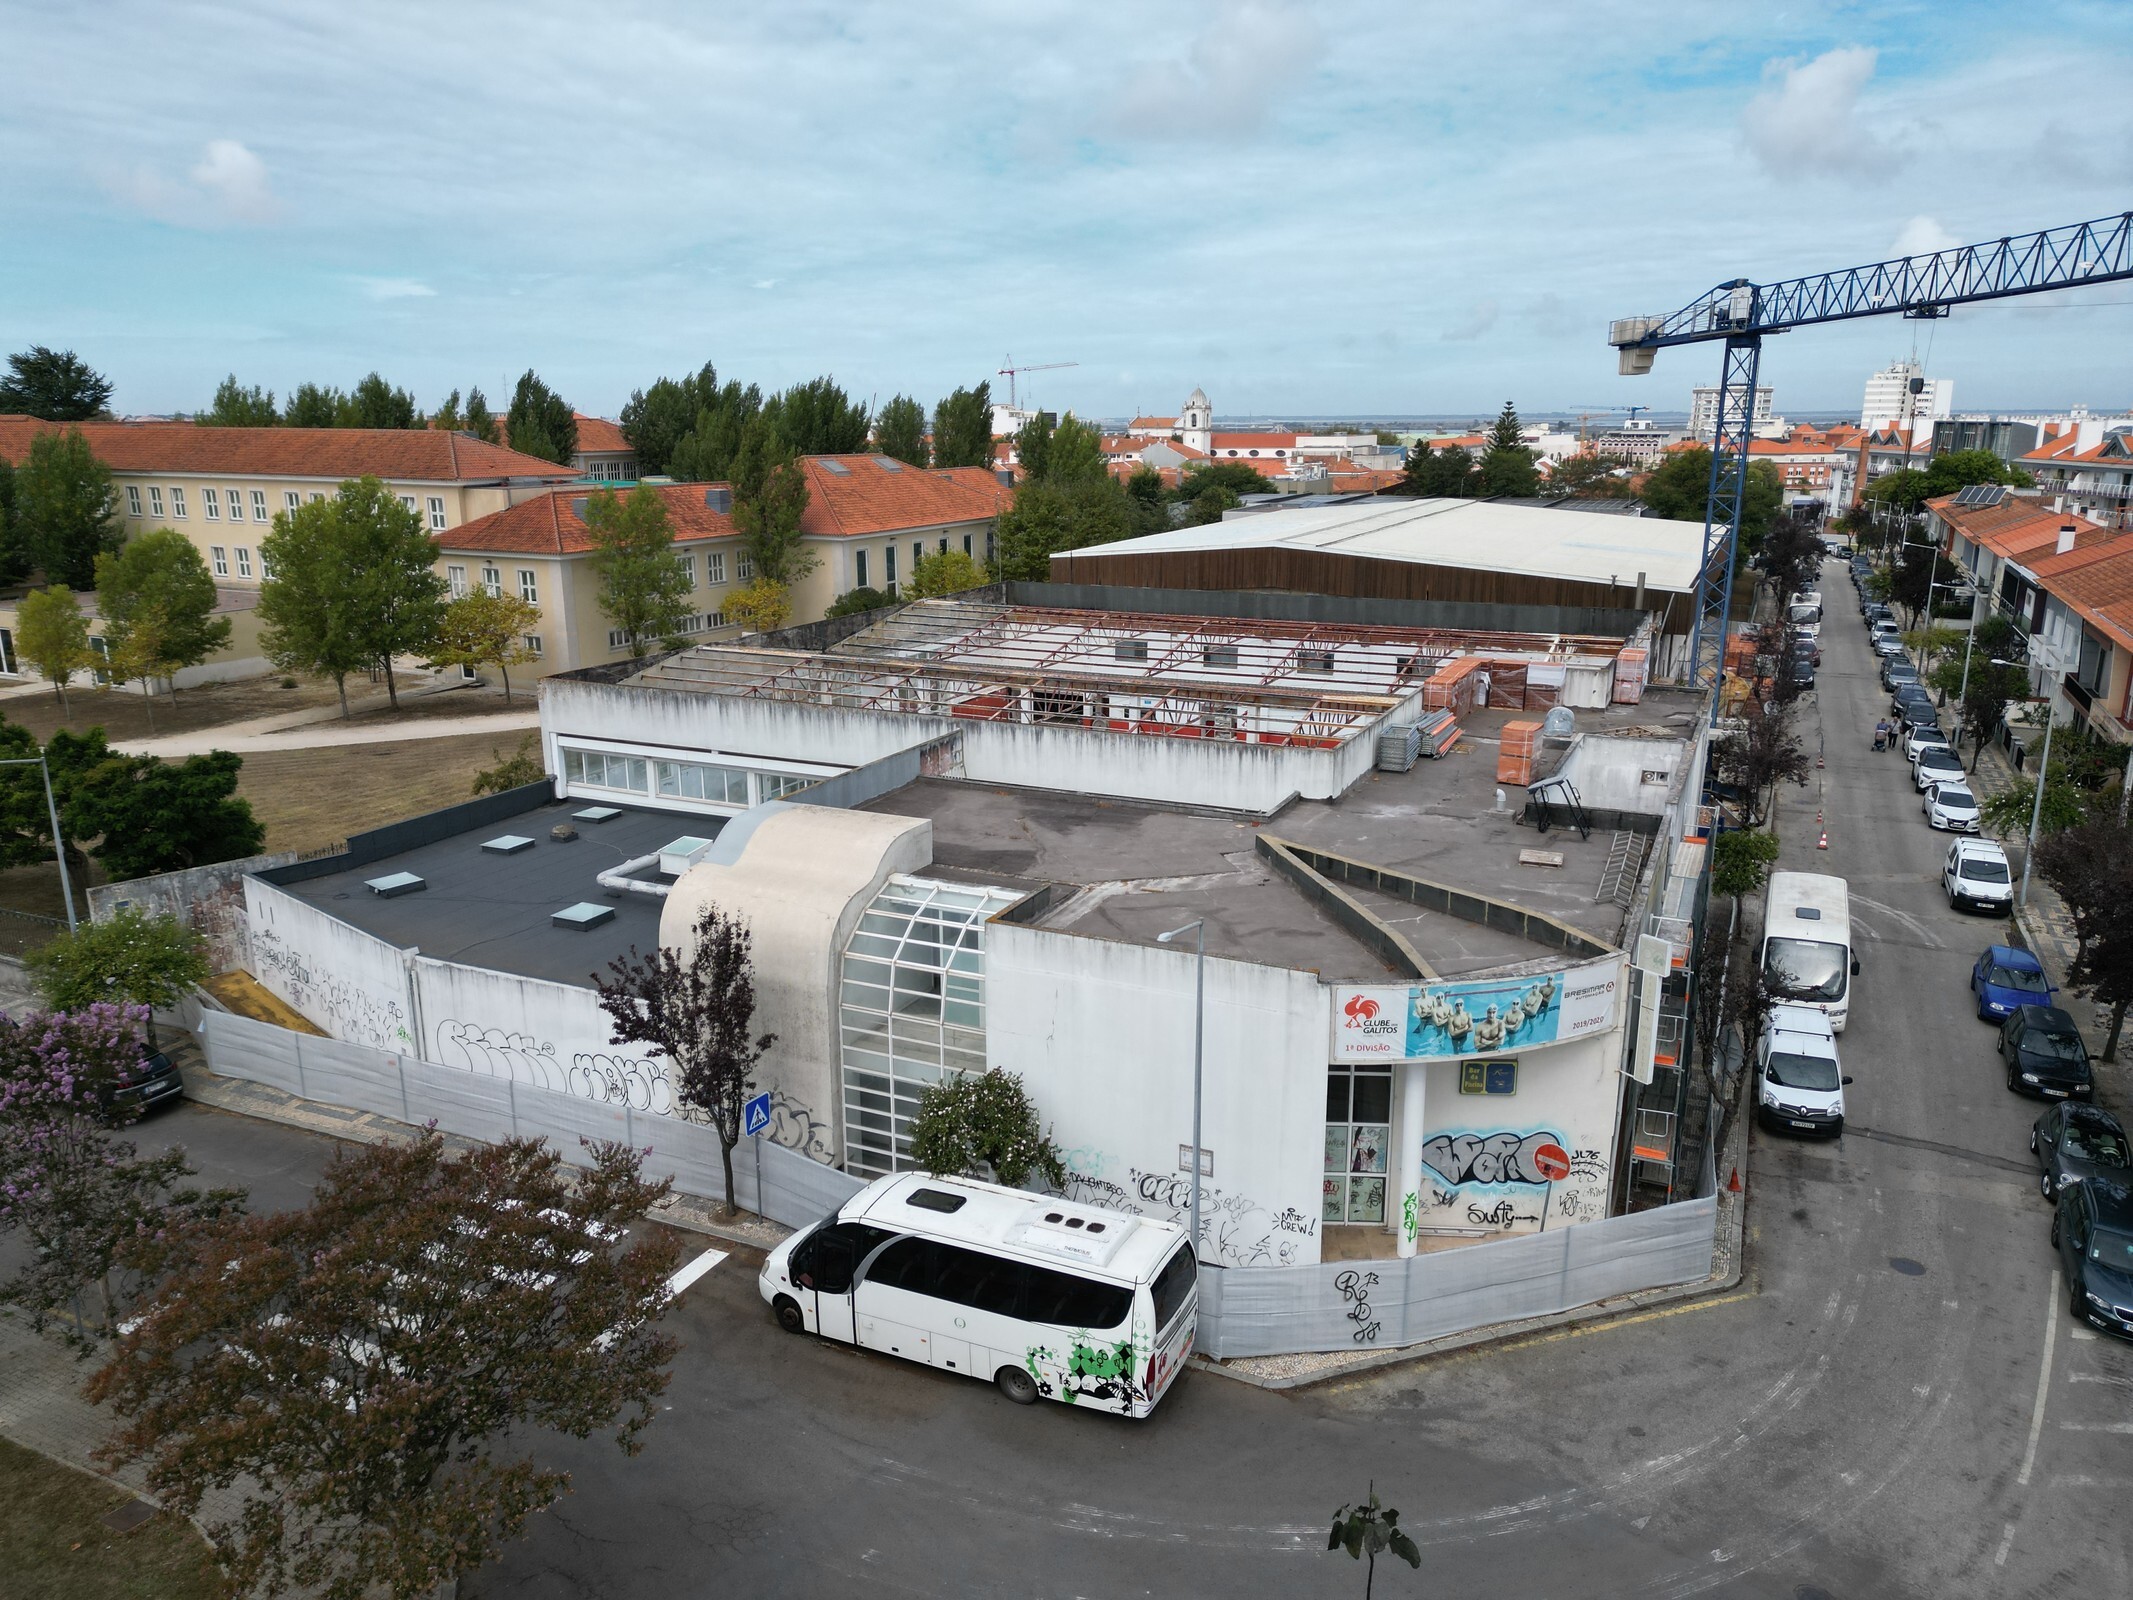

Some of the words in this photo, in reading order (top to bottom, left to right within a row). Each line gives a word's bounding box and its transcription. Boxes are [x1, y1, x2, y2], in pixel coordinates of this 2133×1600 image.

[1564, 984, 1605, 998] BRESIMAR
[1363, 1019, 1391, 1027] CLUBE
[1572, 1016, 1604, 1029] 2019/2020
[1362, 1026, 1398, 1034] GALITOS
[1356, 1043, 1391, 1052] DIVISÃO
